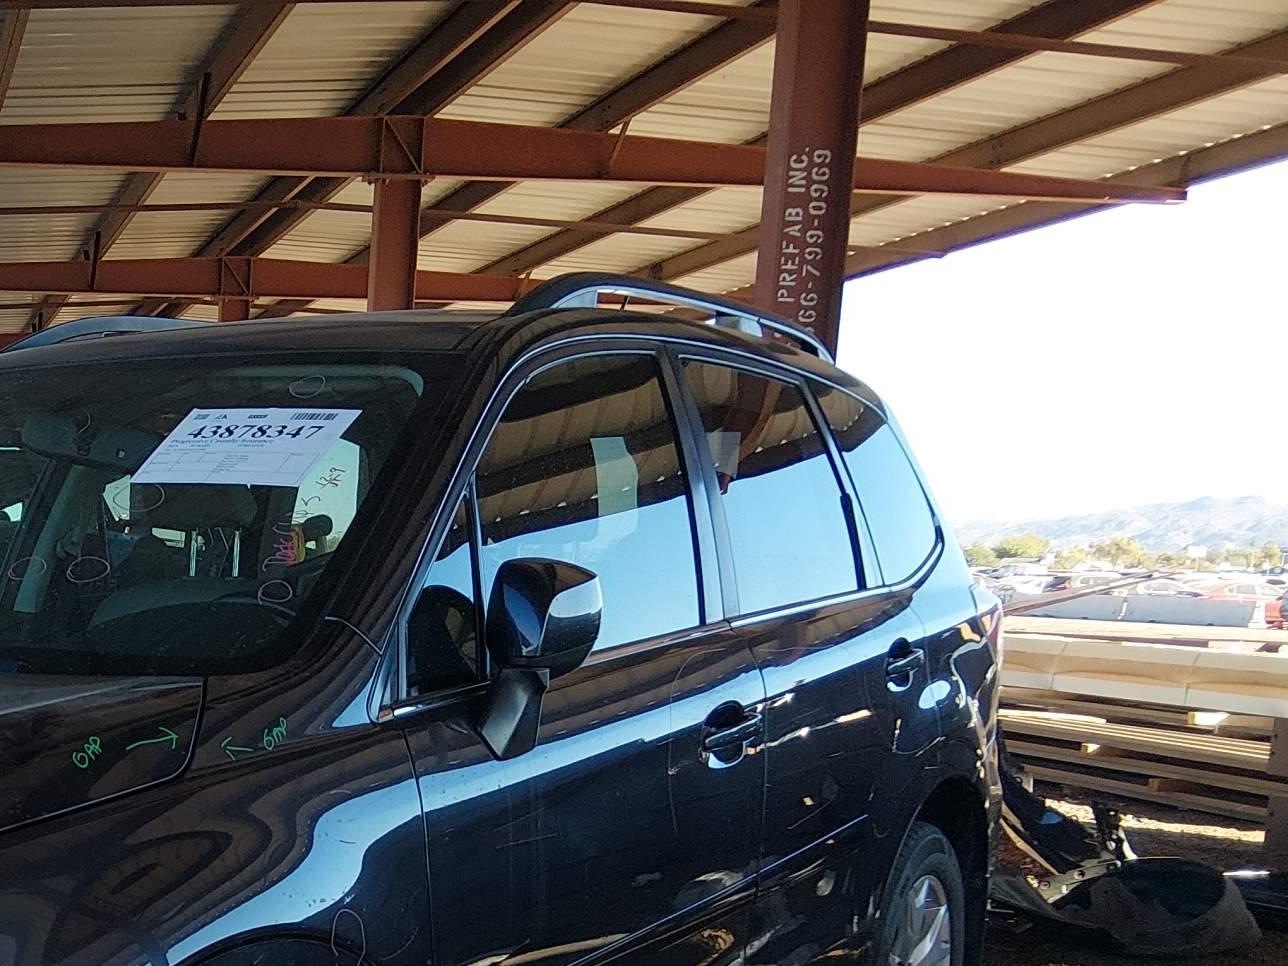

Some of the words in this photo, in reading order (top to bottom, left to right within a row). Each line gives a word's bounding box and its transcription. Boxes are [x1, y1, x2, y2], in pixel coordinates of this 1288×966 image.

[788, 147, 810, 193] INC.
[777, 207, 804, 303] PREFAB
[187, 424, 325, 439] 43878347
[263, 716, 288, 751] GAP
[72, 736, 101, 769] GAP
